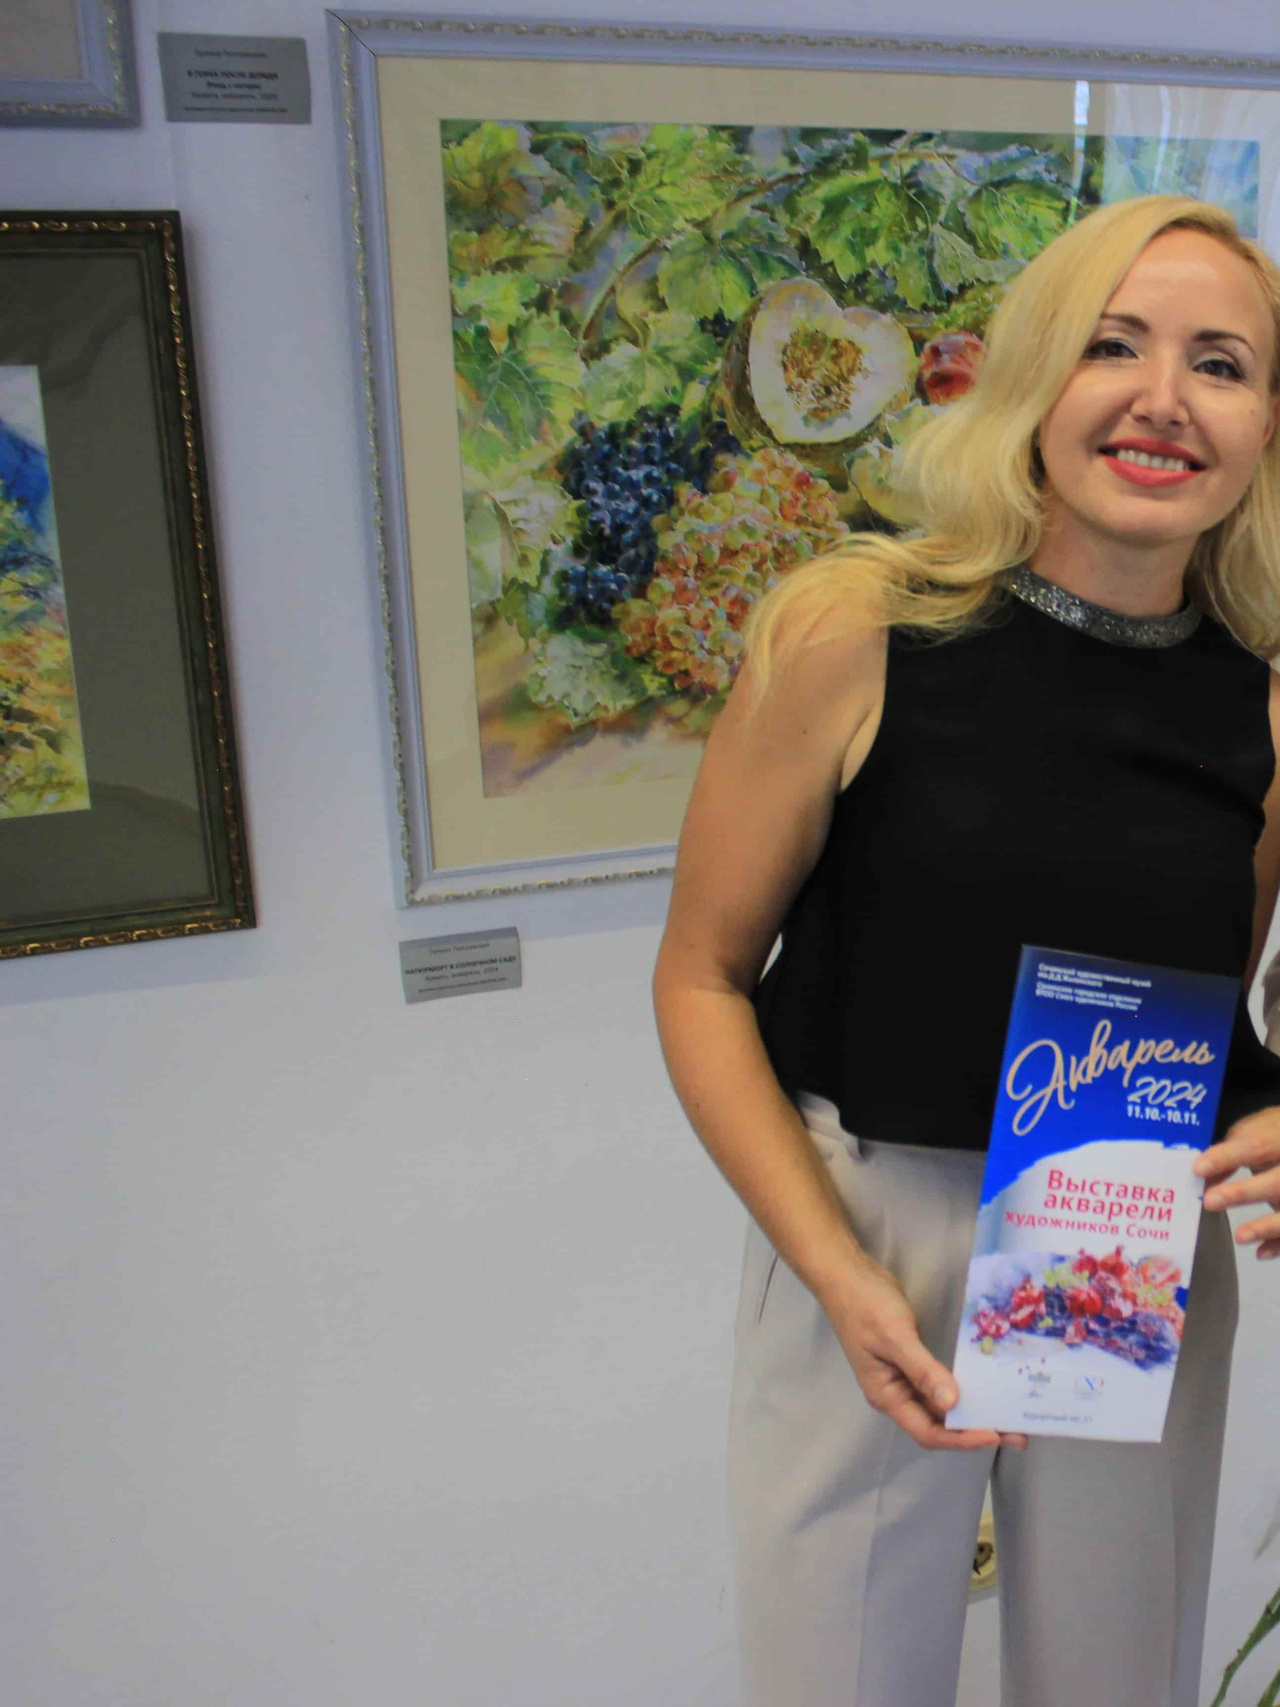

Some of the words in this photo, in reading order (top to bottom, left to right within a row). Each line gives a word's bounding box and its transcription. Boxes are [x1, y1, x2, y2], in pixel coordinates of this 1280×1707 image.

[1006, 1019, 1216, 1137] Акварель
[1127, 1076, 1207, 1109] 2024
[1048, 1169, 1176, 1204] Выставка
[1044, 1193, 1173, 1222] акварели
[1004, 1210, 1120, 1236] художников
[1126, 1222, 1171, 1241] Сочи
